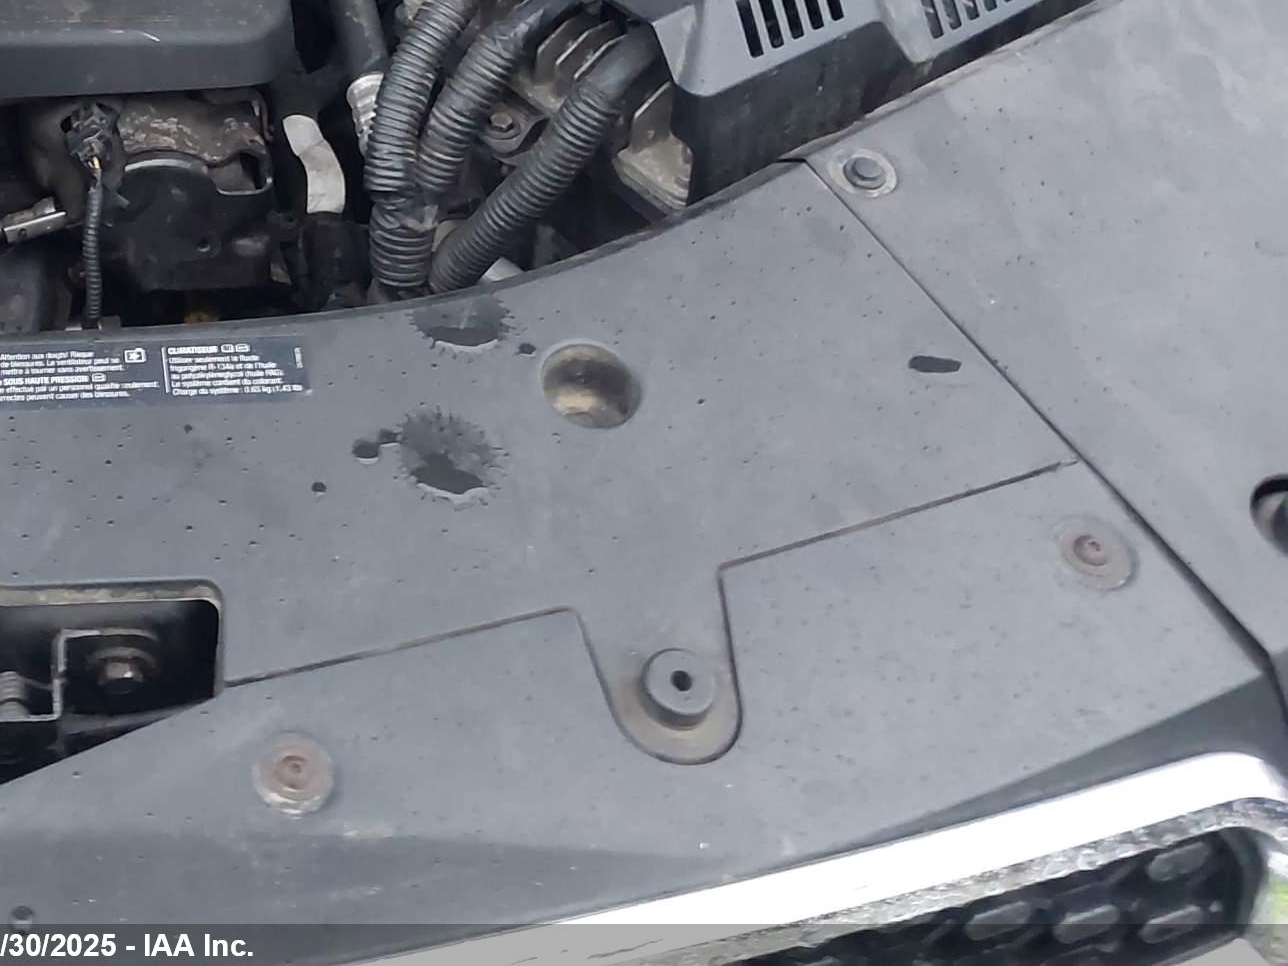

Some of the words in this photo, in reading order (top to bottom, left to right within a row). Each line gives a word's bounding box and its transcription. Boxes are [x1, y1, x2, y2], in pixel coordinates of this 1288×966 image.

[3, 378, 24, 386] SOUS
[25, 376, 50, 385] HAUTE
[50, 375, 90, 384] PRESSION
